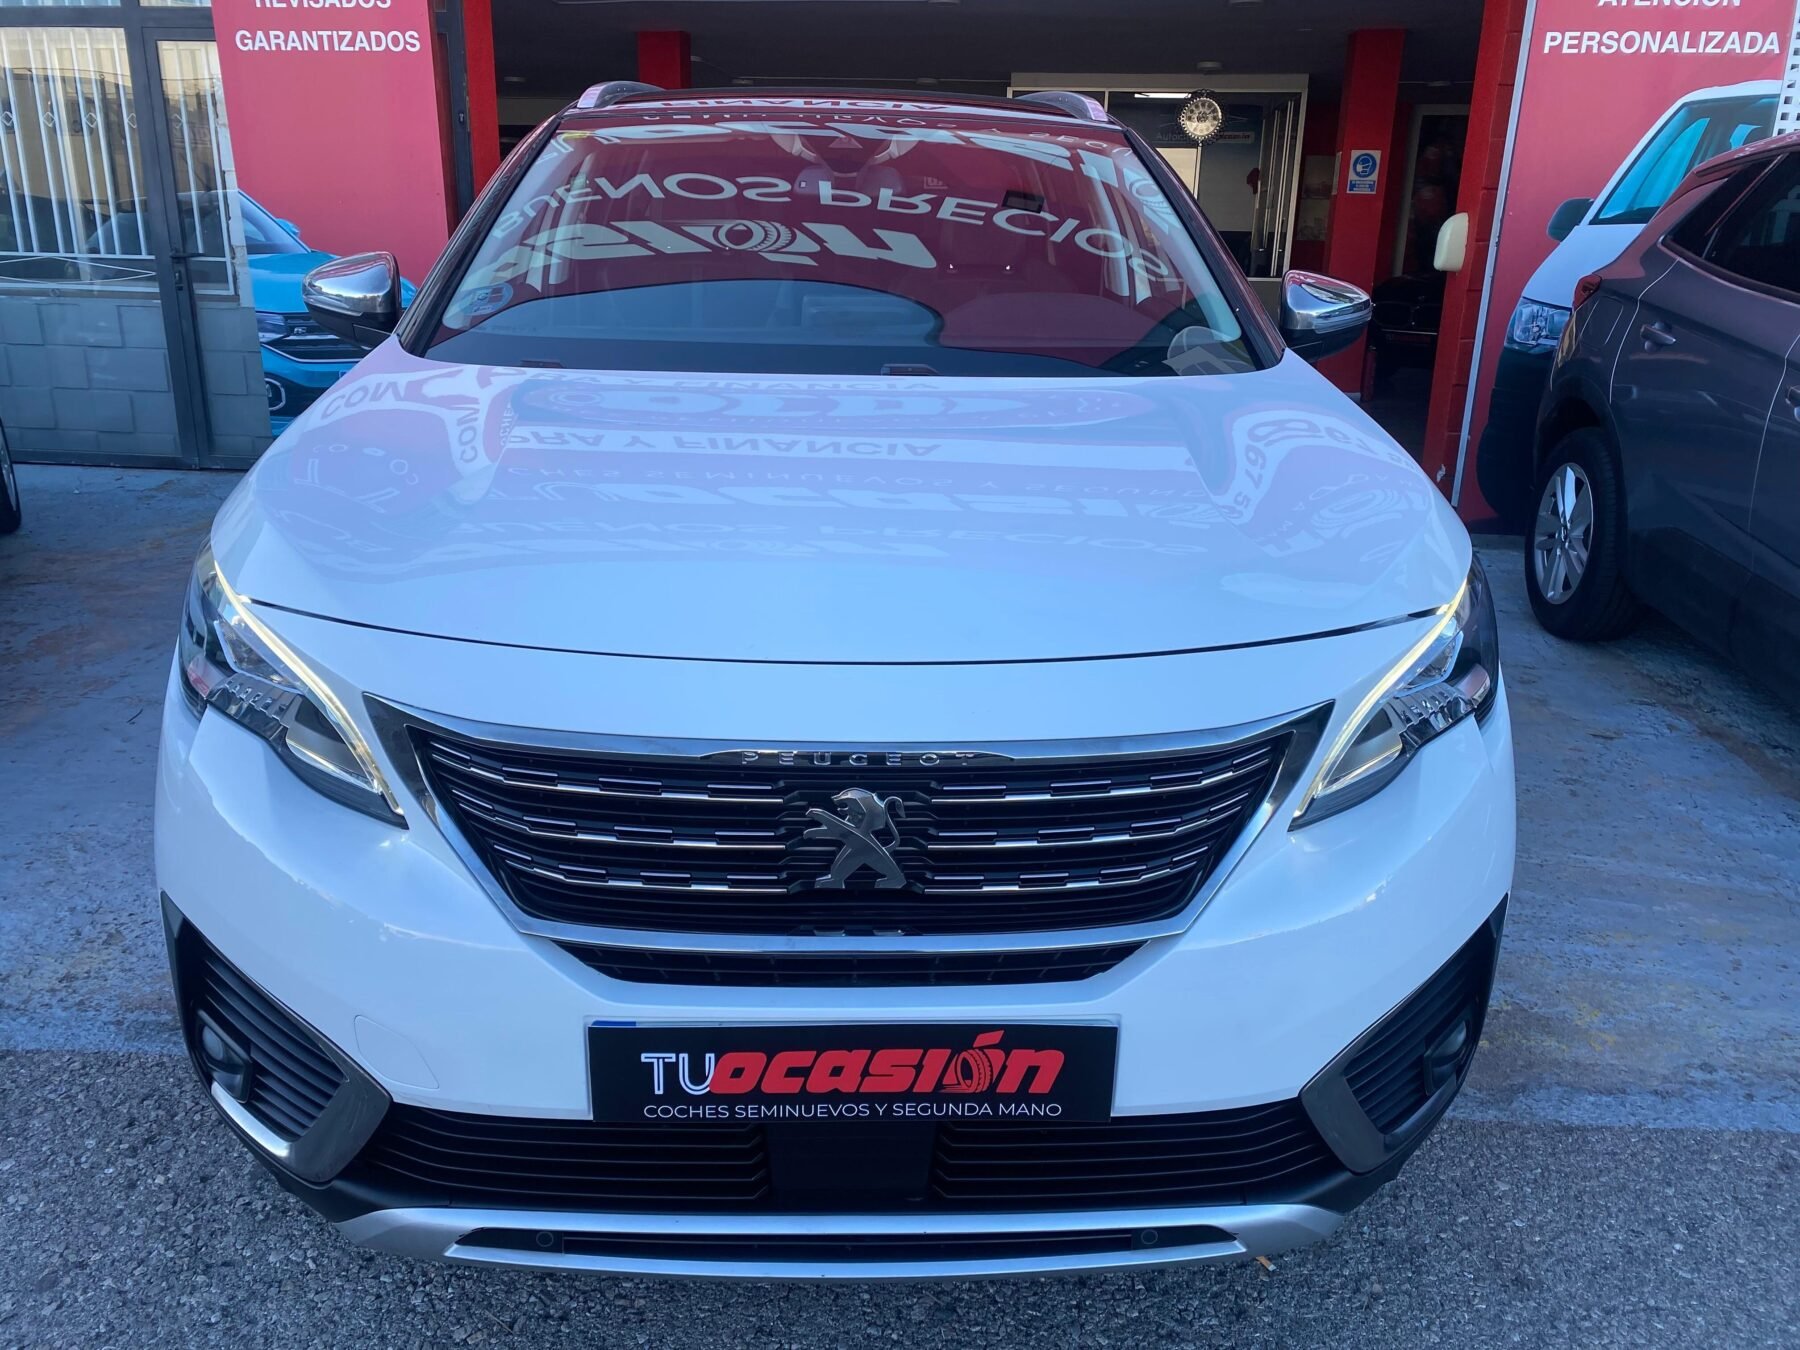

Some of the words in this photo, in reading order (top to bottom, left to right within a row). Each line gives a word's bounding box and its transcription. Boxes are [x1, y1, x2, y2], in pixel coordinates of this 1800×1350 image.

[235, 30, 421, 52] GARANTIZADOS
[1543, 31, 1781, 54] PERSONALIZADA
[741, 750, 976, 766] PEUGEOT
[643, 1104, 730, 1119] COCHES
[735, 1103, 870, 1118] SEMINUEVOS
[874, 1103, 888, 1116] Y
[892, 1103, 993, 1117] SEGUNDA
[999, 1103, 1062, 1117] MANO
